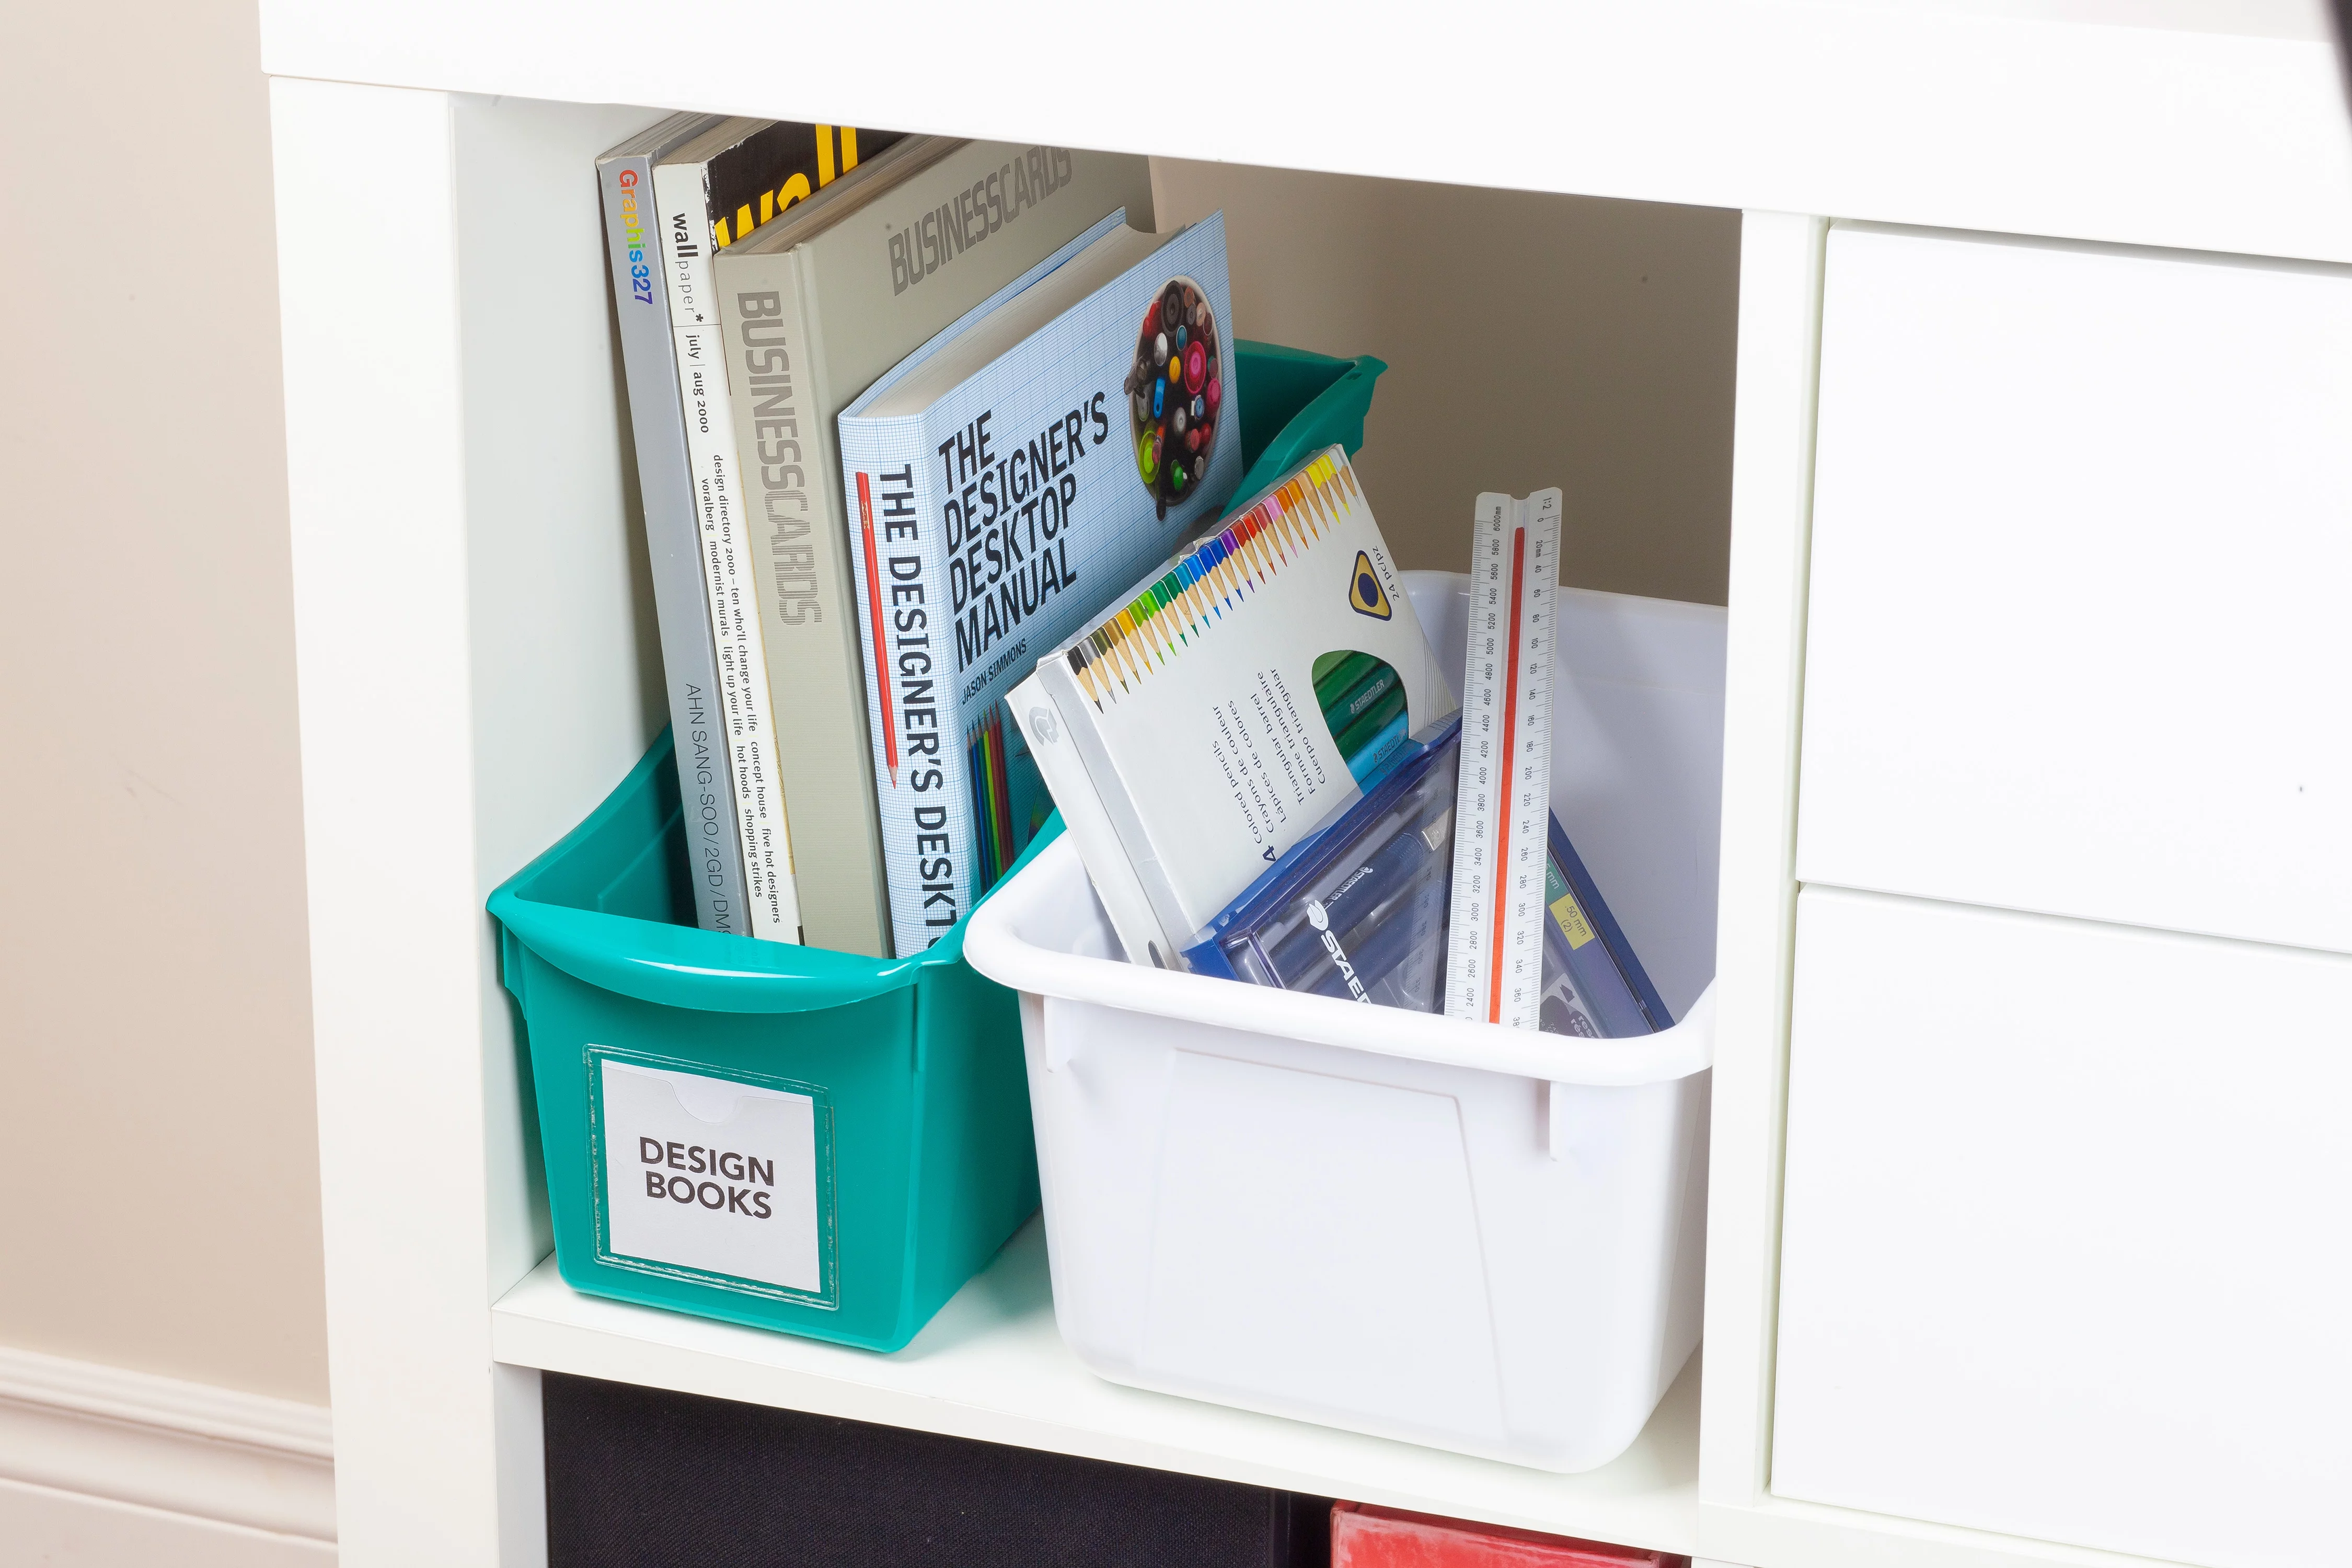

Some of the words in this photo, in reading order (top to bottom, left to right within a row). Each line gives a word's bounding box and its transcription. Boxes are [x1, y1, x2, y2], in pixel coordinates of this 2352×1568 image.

[619, 169, 653, 305] Graphis327
[888, 145, 1073, 296] BUSINESSCARDS
[686, 335, 701, 359] july
[693, 372, 705, 396] aug
[697, 400, 709, 433] 2000
[737, 291, 822, 626] BUSINESSCARDS
[939, 410, 995, 494] THE
[713, 455, 725, 491] design
[944, 391, 1108, 558] DESIGNER'S
[701, 478, 714, 531] voralberg
[719, 495, 732, 544] directory
[880, 464, 918, 543] THE
[726, 548, 735, 575] 2000
[950, 473, 1076, 616] DESKTOP
[709, 541, 724, 596] modernist
[955, 537, 1077, 674] MANUAL
[1388, 583, 1400, 601] 24
[1534, 589, 1540, 598] 60
[717, 599, 730, 636] murals
[734, 608, 746, 641] who'll
[1532, 614, 1540, 622] 80
[722, 647, 734, 671] light
[739, 645, 750, 684] change
[889, 556, 943, 793] DESIGNER'S
[962, 671, 987, 705] JASON
[988, 638, 1027, 682] SIMMONS
[726, 675, 735, 688] up
[741, 687, 754, 711] your
[1354, 679, 1385, 711] STAEDTLER
[686, 683, 706, 725] AHN
[727, 691, 739, 715] your
[1250, 693, 1273, 734] barrel
[1258, 671, 1295, 750] triangulaire
[1270, 668, 1304, 734] triangular
[733, 719, 743, 736] life
[747, 714, 757, 731] life
[1213, 706, 1238, 755] couleur
[1228, 700, 1252, 748] colores
[736, 746, 746, 763] hot
[751, 742, 764, 783] concept
[1213, 741, 1239, 788] pencils
[1238, 758, 1248, 775] de
[1252, 752, 1262, 769] de
[1271, 737, 1305, 805] Triangular
[1302, 736, 1325, 784] Cuerpo
[739, 767, 751, 799] hoods
[1294, 752, 1316, 794] Forme
[757, 787, 766, 818] house
[1247, 779, 1274, 833] Crayons
[1261, 772, 1287, 823] Lápices
[744, 809, 757, 859] shopping
[1235, 792, 1262, 844] Colored
[762, 828, 771, 847] five
[765, 851, 774, 868] hot
[1474, 847, 1482, 866] 3400
[751, 861, 763, 897] strikes
[914, 806, 957, 949] DESKT
[1331, 871, 1365, 901] STAEDTLER
[1472, 875, 1481, 894] 3200
[1546, 871, 1560, 889] mm
[767, 871, 780, 924] designers
[1471, 903, 1479, 921] 3000
[1561, 919, 1573, 932] (2)
[1565, 905, 1577, 918] .50
[1574, 919, 1587, 936] mm
[1469, 930, 1478, 950] 2800
[1468, 959, 1476, 978] 2600
[1578, 1016, 1595, 1039] res
[639, 1136, 775, 1187] DESIGN
[645, 1171, 772, 1219] BOOKS
